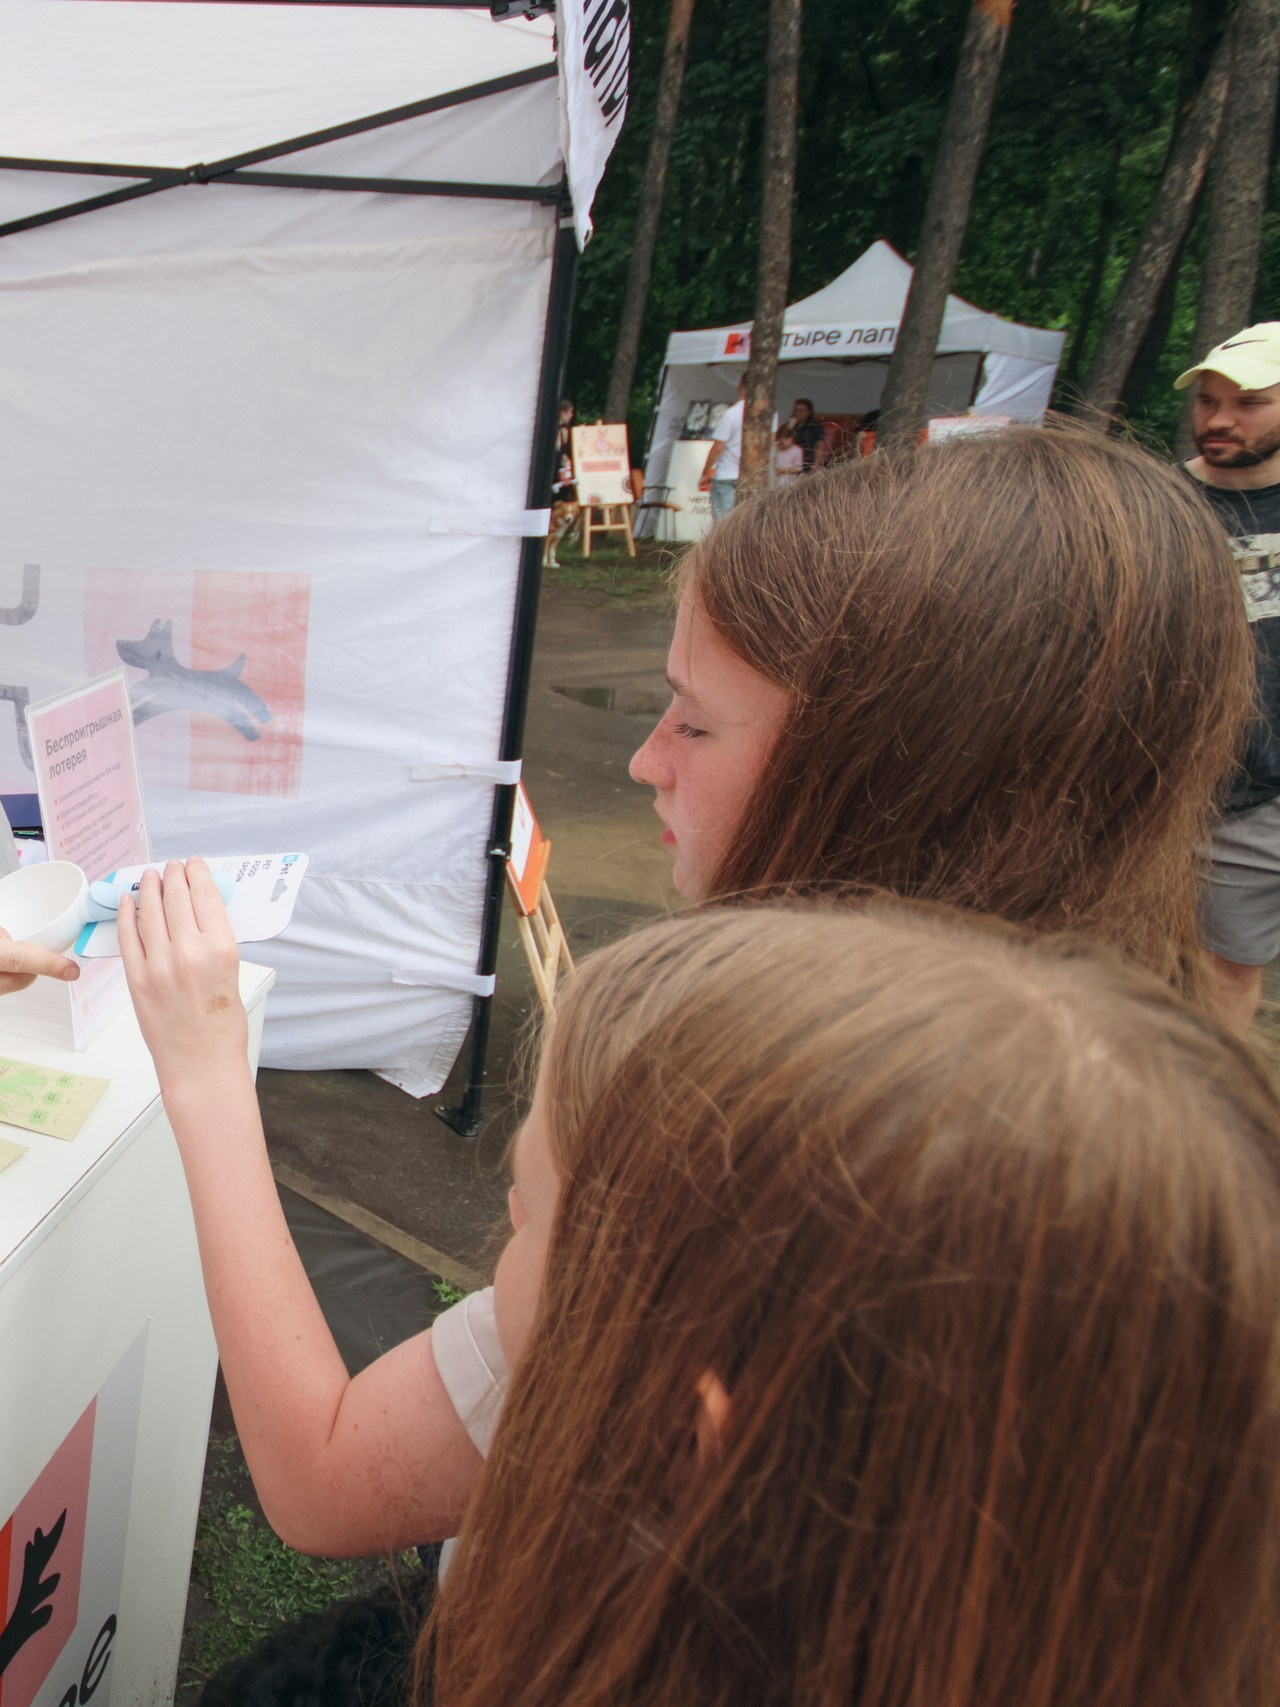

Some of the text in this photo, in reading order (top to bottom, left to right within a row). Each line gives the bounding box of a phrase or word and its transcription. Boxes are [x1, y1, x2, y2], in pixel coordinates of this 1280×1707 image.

[782, 326, 898, 347] тыре лап
[45, 708, 123, 756] Беспроигрышная
[49, 749, 88, 780] лотерея
[235, 860, 250, 883] SPOON
[248, 860, 261, 878] FOOD
[261, 859, 272, 871] PET
